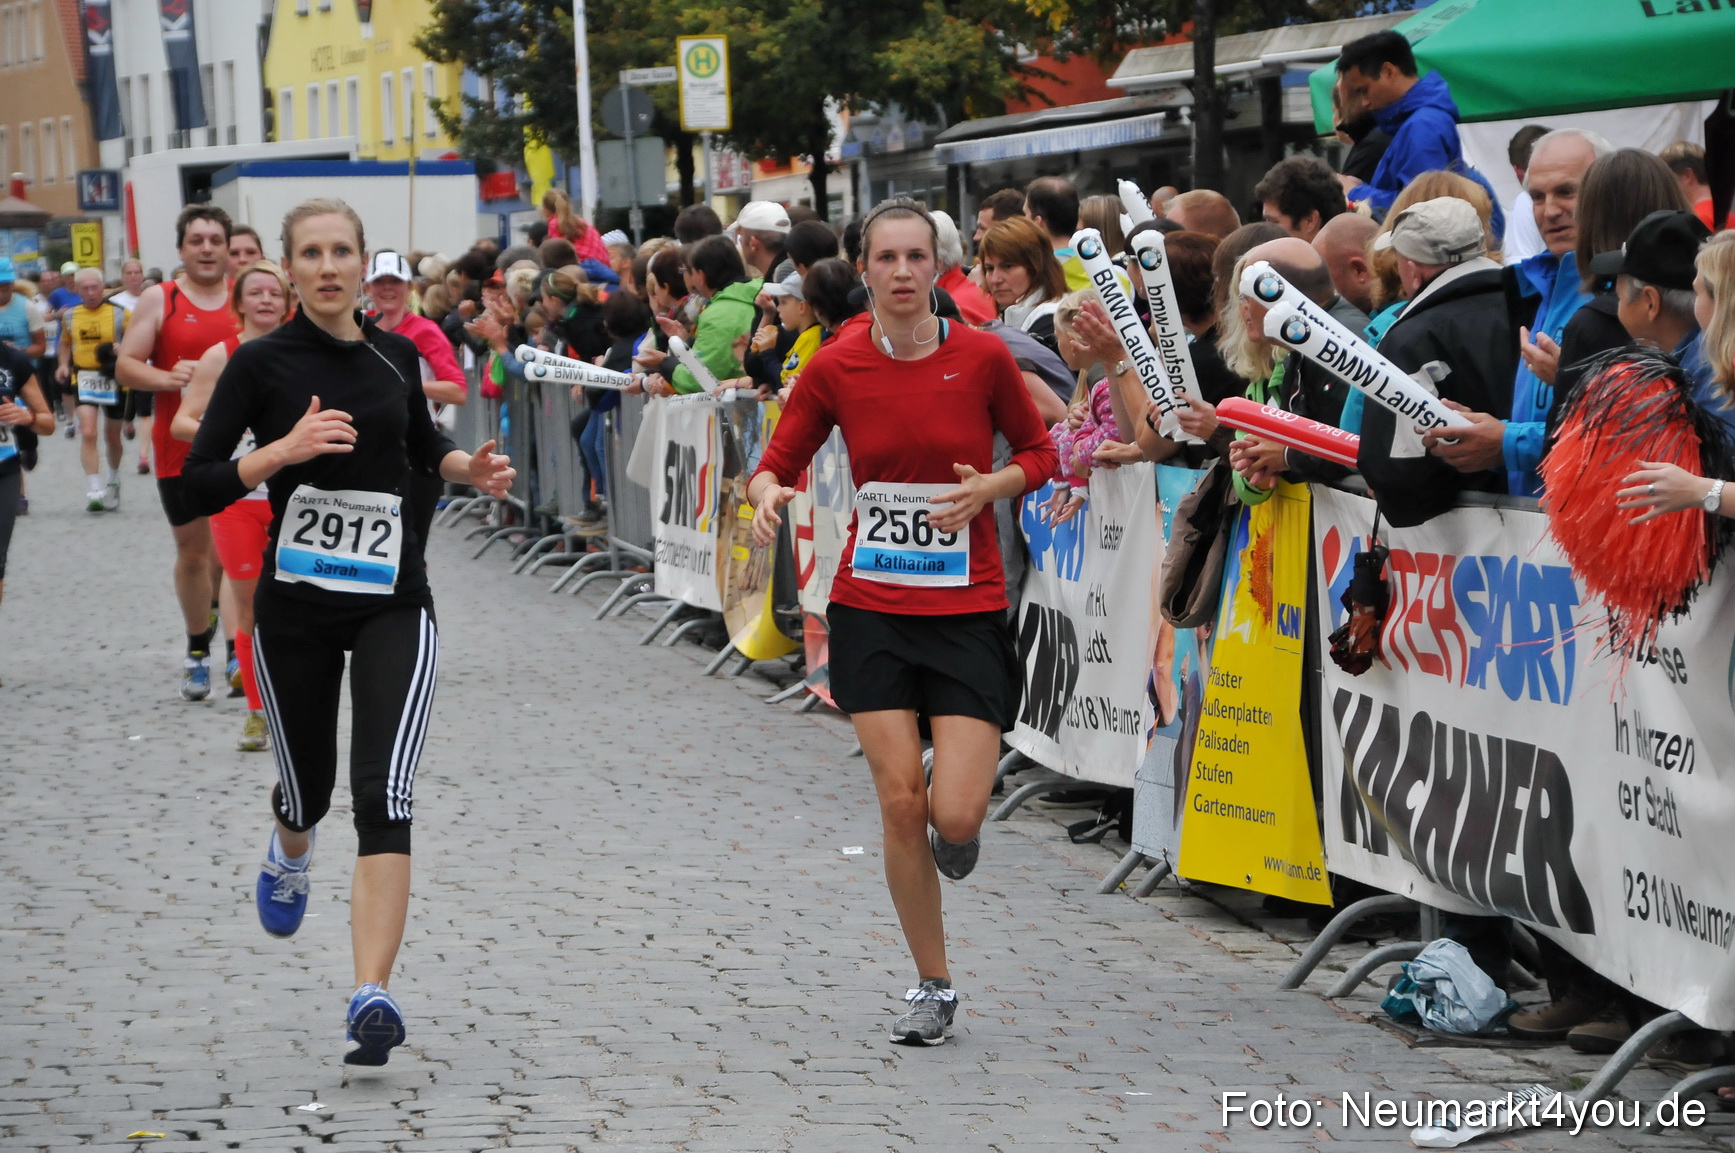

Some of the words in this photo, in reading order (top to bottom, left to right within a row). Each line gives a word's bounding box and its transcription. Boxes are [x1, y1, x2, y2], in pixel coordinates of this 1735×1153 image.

[80, 236, 94, 257] D
[1093, 267, 1133, 321] BMW
[1119, 321, 1176, 418] Laufsport
[554, 368, 584, 381] BMW
[1316, 338, 1381, 388] BMW
[1308, 421, 1345, 437] BKK
[291, 493, 331, 505] PARTL
[332, 498, 387, 514] Neumarkt
[856, 492, 891, 503] PARTL
[893, 493, 932, 504] Neuma
[292, 508, 393, 559] 2912
[312, 558, 359, 578] Sarah
[874, 552, 946, 573] Katharina
[1208, 666, 1243, 689] Pflaster
[1202, 697, 1273, 726] Außenplatten
[1198, 728, 1250, 755] Palisaden
[1195, 761, 1233, 785] Stufen
[1193, 793, 1276, 826] Gartenmauern
